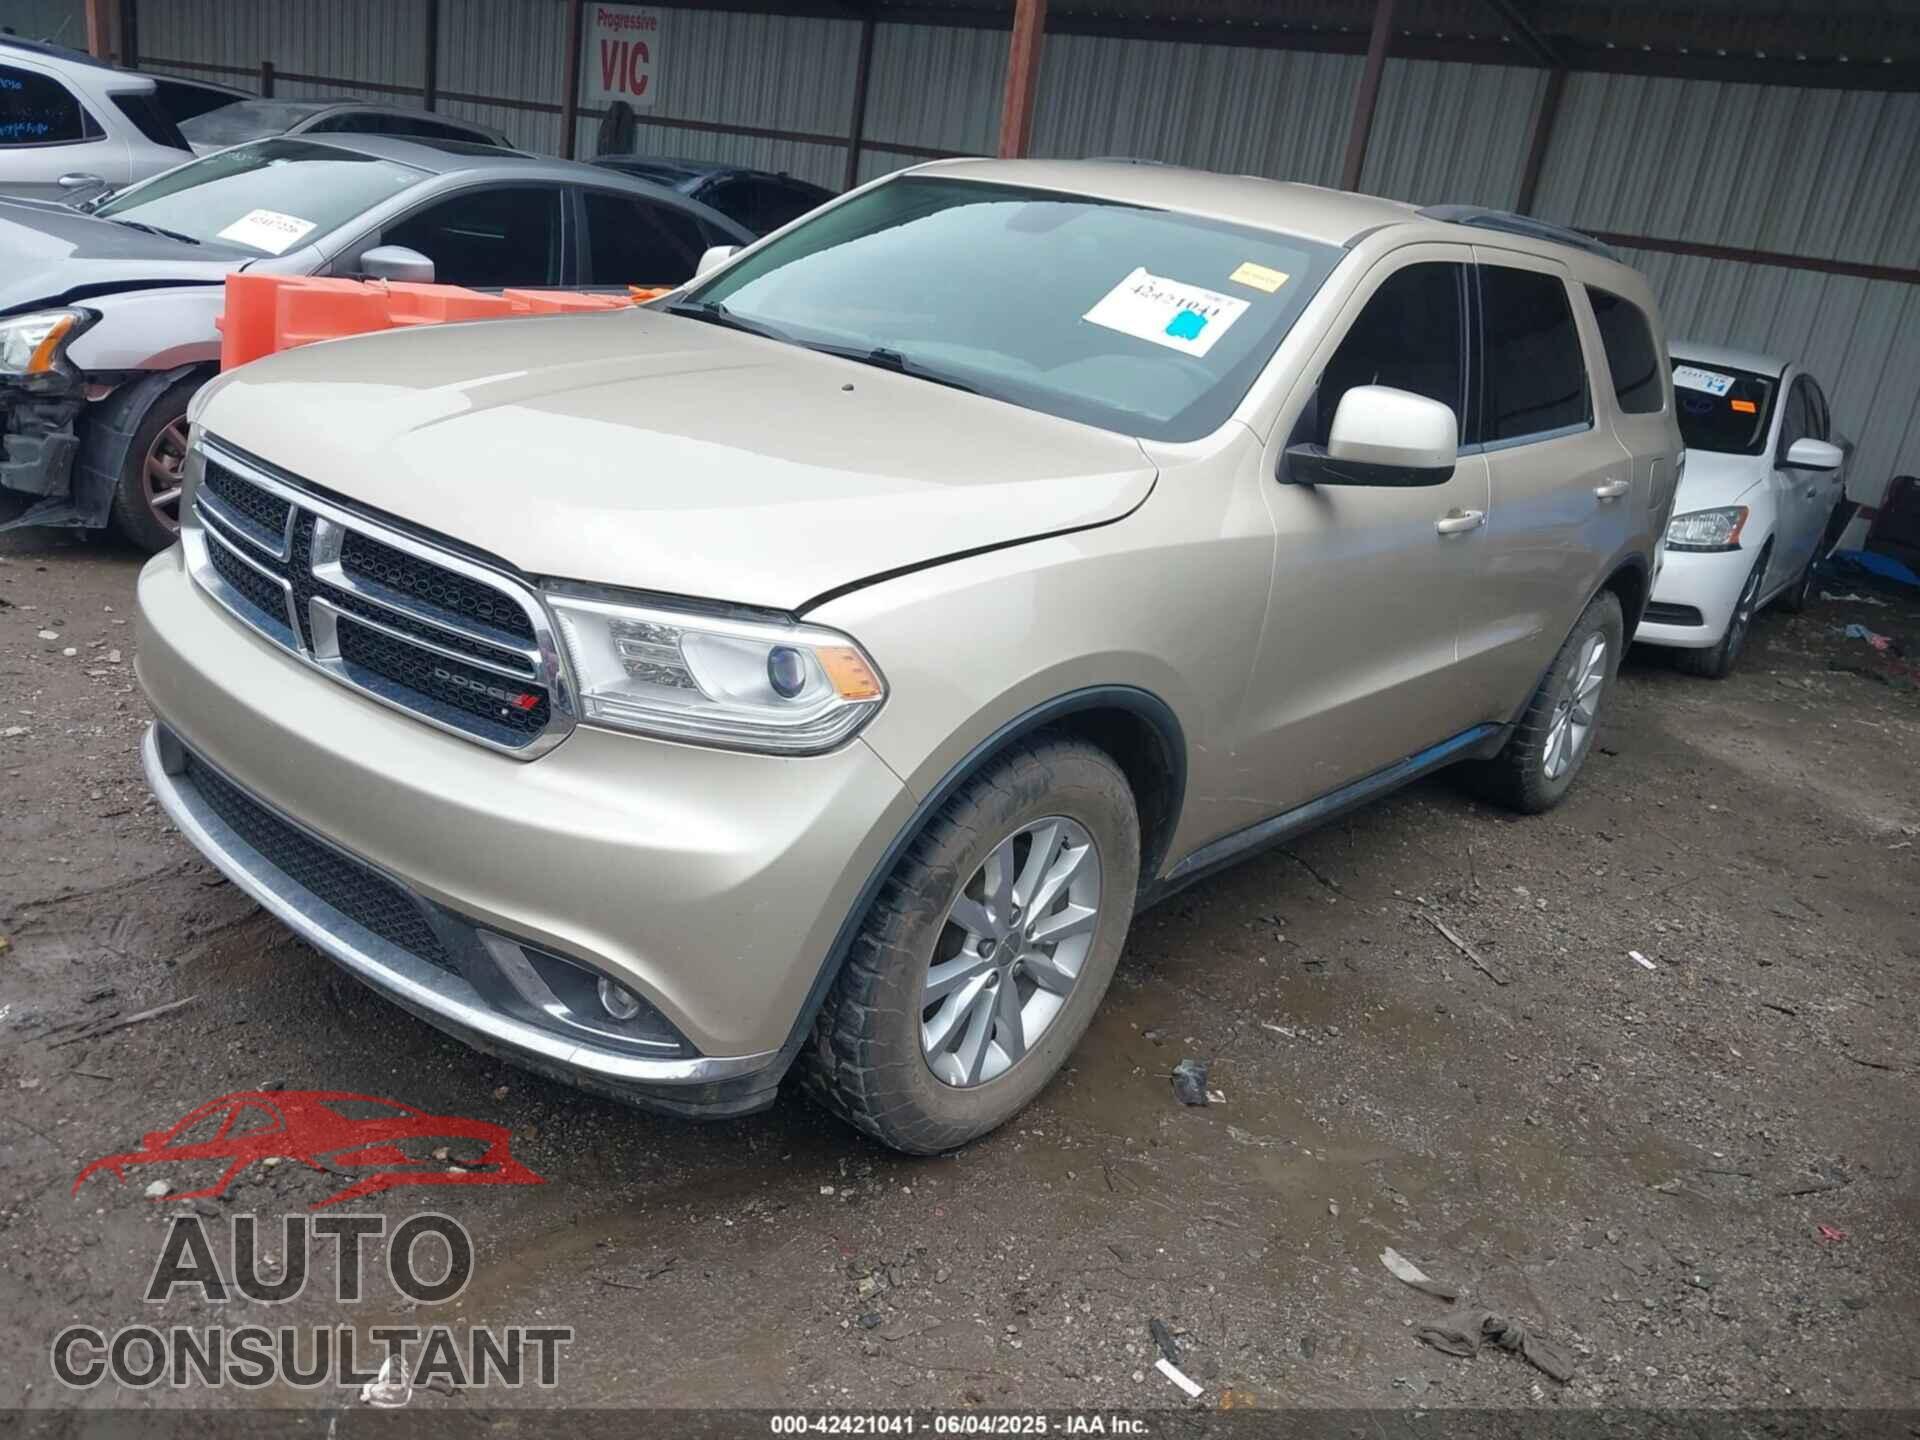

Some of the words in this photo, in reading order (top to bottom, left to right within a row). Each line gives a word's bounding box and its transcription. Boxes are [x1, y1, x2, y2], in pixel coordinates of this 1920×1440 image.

[597, 8, 657, 32] Progressive
[600, 39, 648, 96] VIC
[434, 667, 519, 704] DODGE
